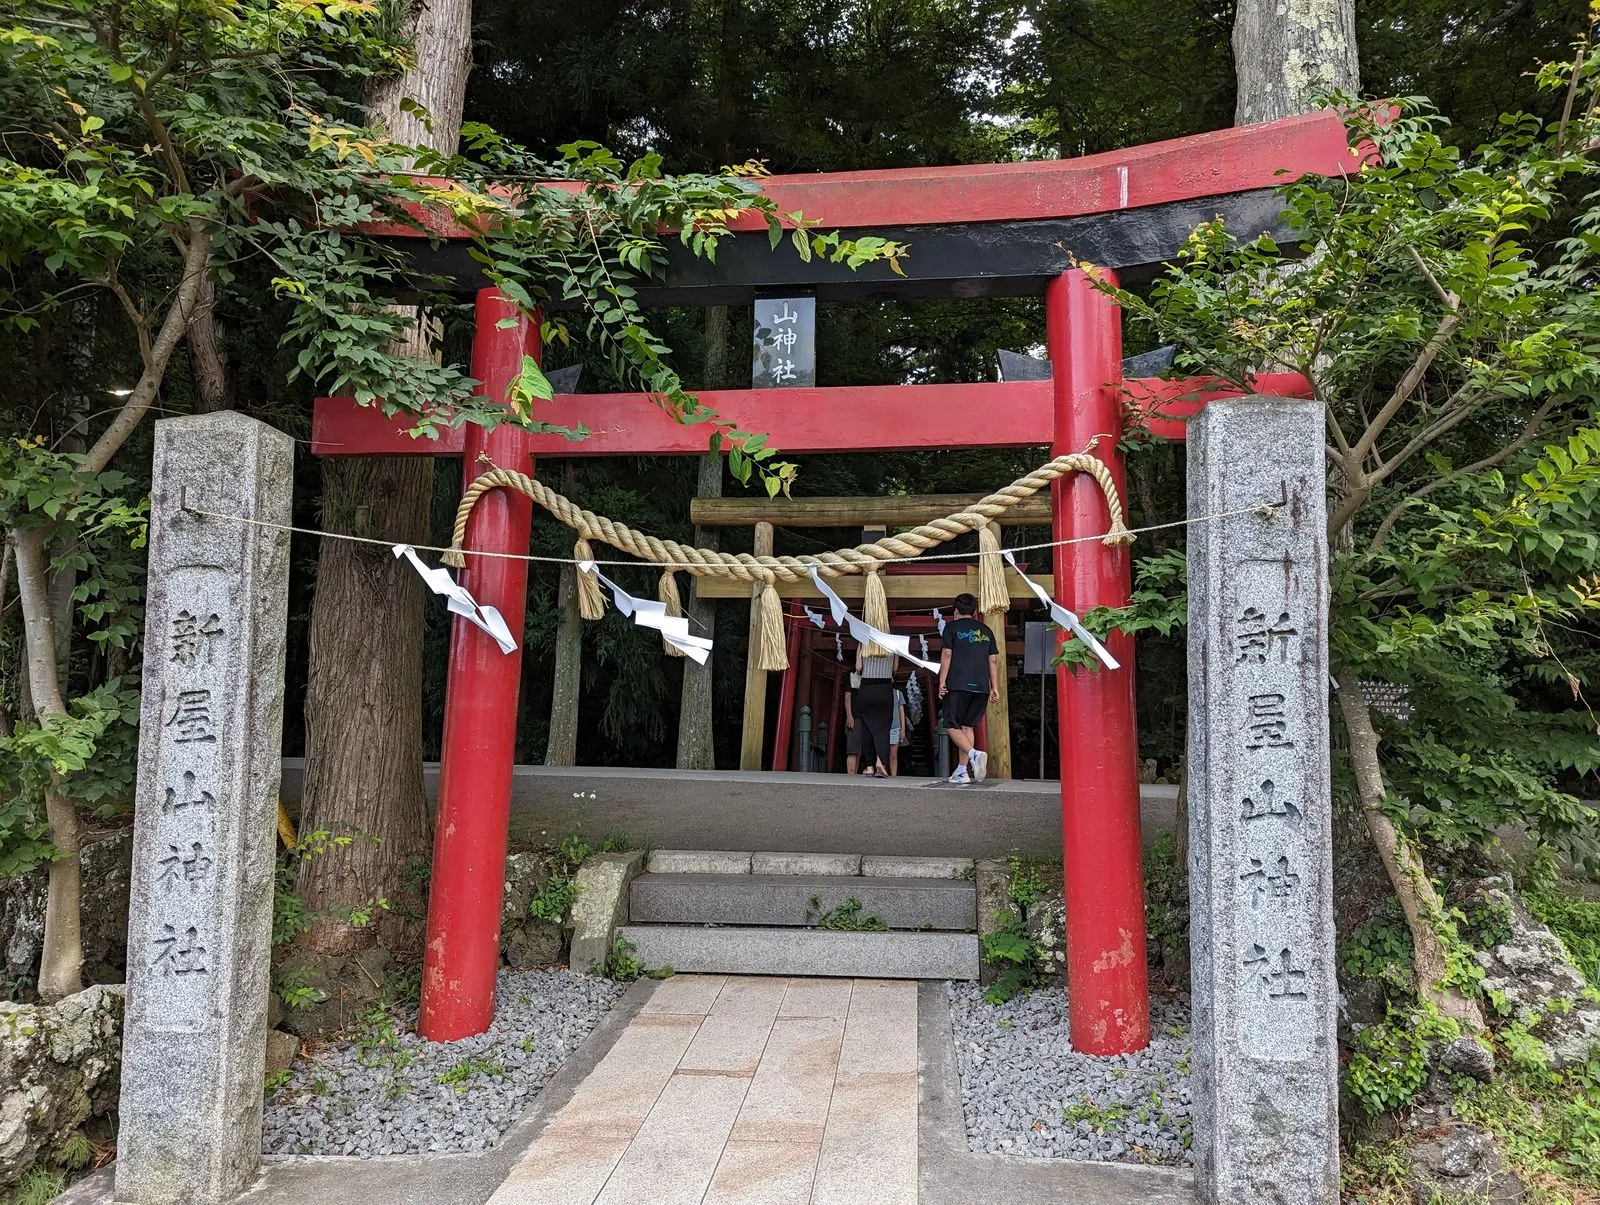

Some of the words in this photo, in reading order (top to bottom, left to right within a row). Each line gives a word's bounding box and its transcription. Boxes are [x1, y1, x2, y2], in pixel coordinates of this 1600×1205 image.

[772, 301, 798, 384] 山神社
[152, 609, 225, 977] 新屋山神社
[1234, 607, 1309, 1000] 新屋山神社
